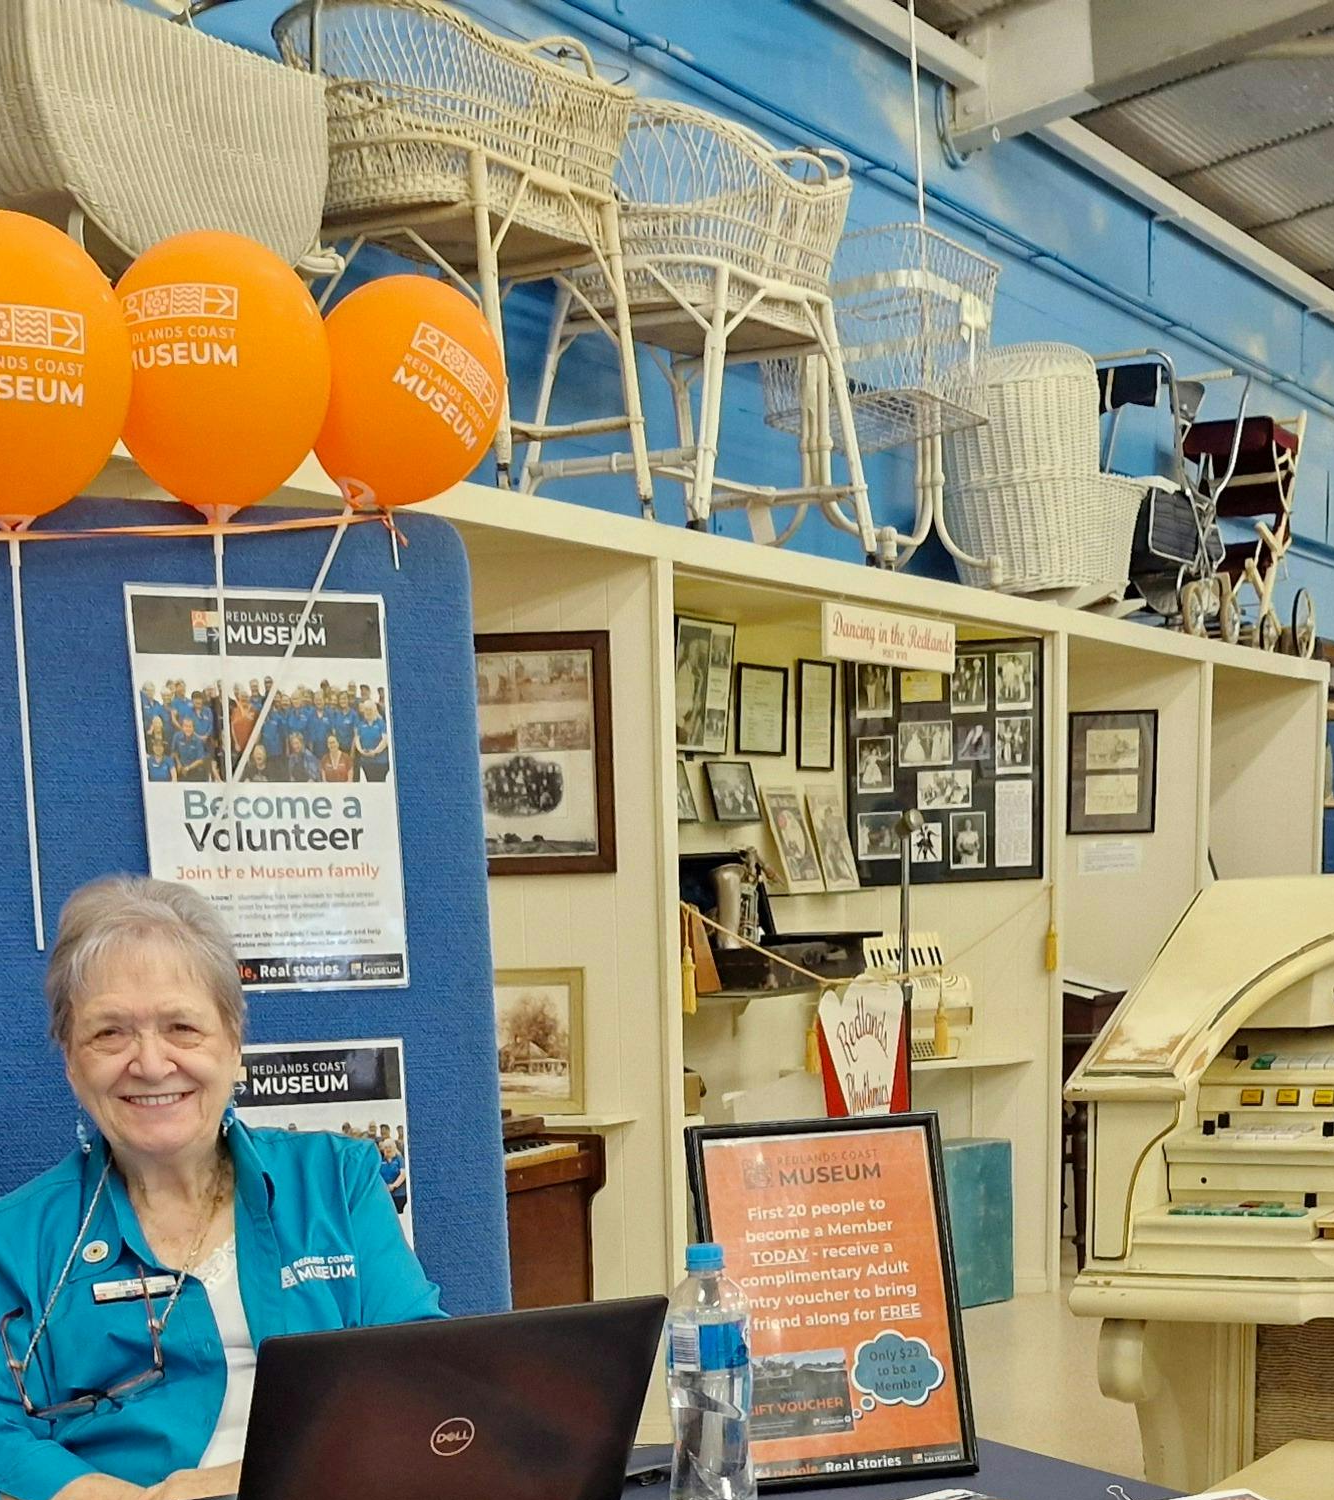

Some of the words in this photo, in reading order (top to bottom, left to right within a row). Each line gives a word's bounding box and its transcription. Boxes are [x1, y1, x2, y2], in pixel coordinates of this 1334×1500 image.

[187, 325, 237, 341] COAST
[34, 357, 85, 377] COAST
[402, 353, 462, 402] REDLANDS
[461, 395, 486, 432] COAST
[392, 366, 478, 451] MUSEUM
[225, 610, 286, 624] REDLANDS
[227, 625, 327, 646] MUSEUM
[833, 611, 876, 651] Dancing
[879, 622, 888, 644] in
[891, 622, 905, 647] the
[907, 623, 953, 655] Redlands
[183, 789, 332, 820] Become
[342, 796, 363, 820] a
[185, 821, 364, 852] Volunteer
[175, 866, 212, 881] Join
[250, 865, 323, 879] Museum
[327, 862, 380, 880] family
[259, 964, 291, 979] Real
[292, 961, 340, 977] stories
[836, 995, 889, 1068] Redlands
[252, 1063, 310, 1075] REDLANDS
[312, 1061, 347, 1072] COAST
[252, 1073, 349, 1096] MUSEUM
[777, 1151, 840, 1166] REDLANDS
[841, 1148, 878, 1161] COAST
[778, 1161, 881, 1187] MUSEUM
[747, 1207, 785, 1222] First
[787, 1203, 807, 1217] 20
[811, 1200, 865, 1219] people
[868, 1198, 886, 1211] to
[745, 1227, 810, 1244] become
[814, 1227, 824, 1238] a
[827, 1219, 893, 1237] Member
[749, 1248, 809, 1267] TODAY
[822, 1243, 879, 1258] receive
[883, 1242, 893, 1254] a
[740, 1264, 862, 1290] complimentary
[866, 1261, 909, 1277] Adult
[787, 1287, 850, 1306] voucher
[853, 1287, 872, 1300] to
[874, 1281, 917, 1300] bring
[753, 1312, 801, 1331] friend
[806, 1311, 850, 1327] along
[854, 1307, 876, 1321] for
[880, 1303, 922, 1321] FREE
[869, 1348, 898, 1364] Only
[877, 1365, 889, 1377] to
[891, 1364, 907, 1376] be
[874, 1379, 924, 1393] Member
[778, 1396, 845, 1414] VOUCHER
[825, 1460, 855, 1473] Real
[856, 1454, 902, 1470] stories
